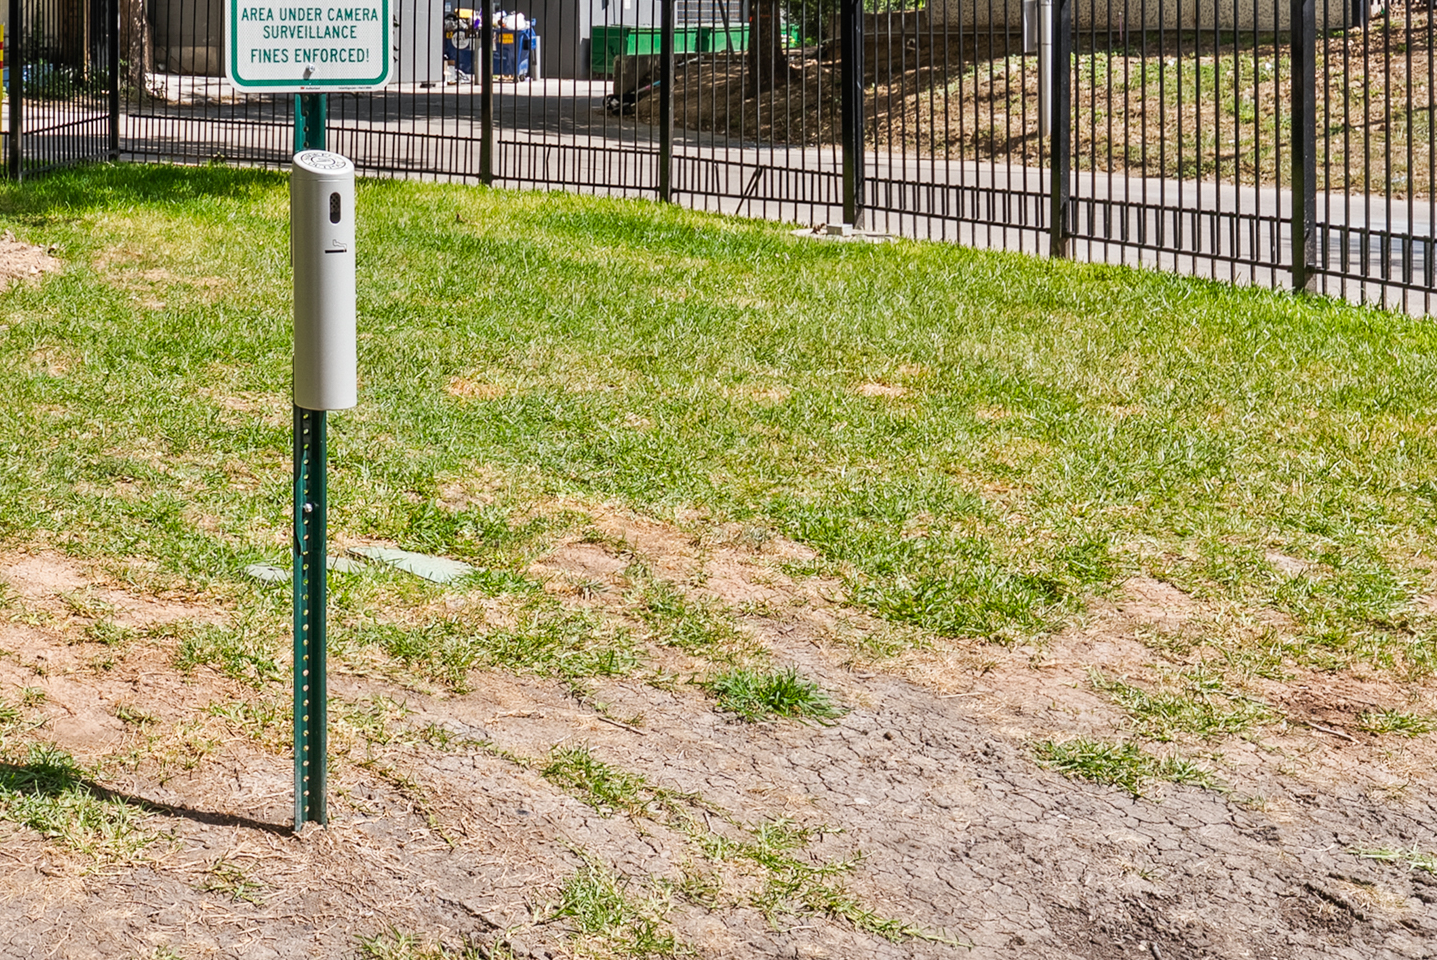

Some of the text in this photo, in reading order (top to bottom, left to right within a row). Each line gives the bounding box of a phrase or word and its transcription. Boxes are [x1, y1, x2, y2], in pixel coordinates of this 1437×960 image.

[241, 8, 378, 22] AREA UNDER CAMERA
[263, 25, 357, 39] SURVEILLANCE
[251, 48, 370, 63] FINES ENFORCED!
